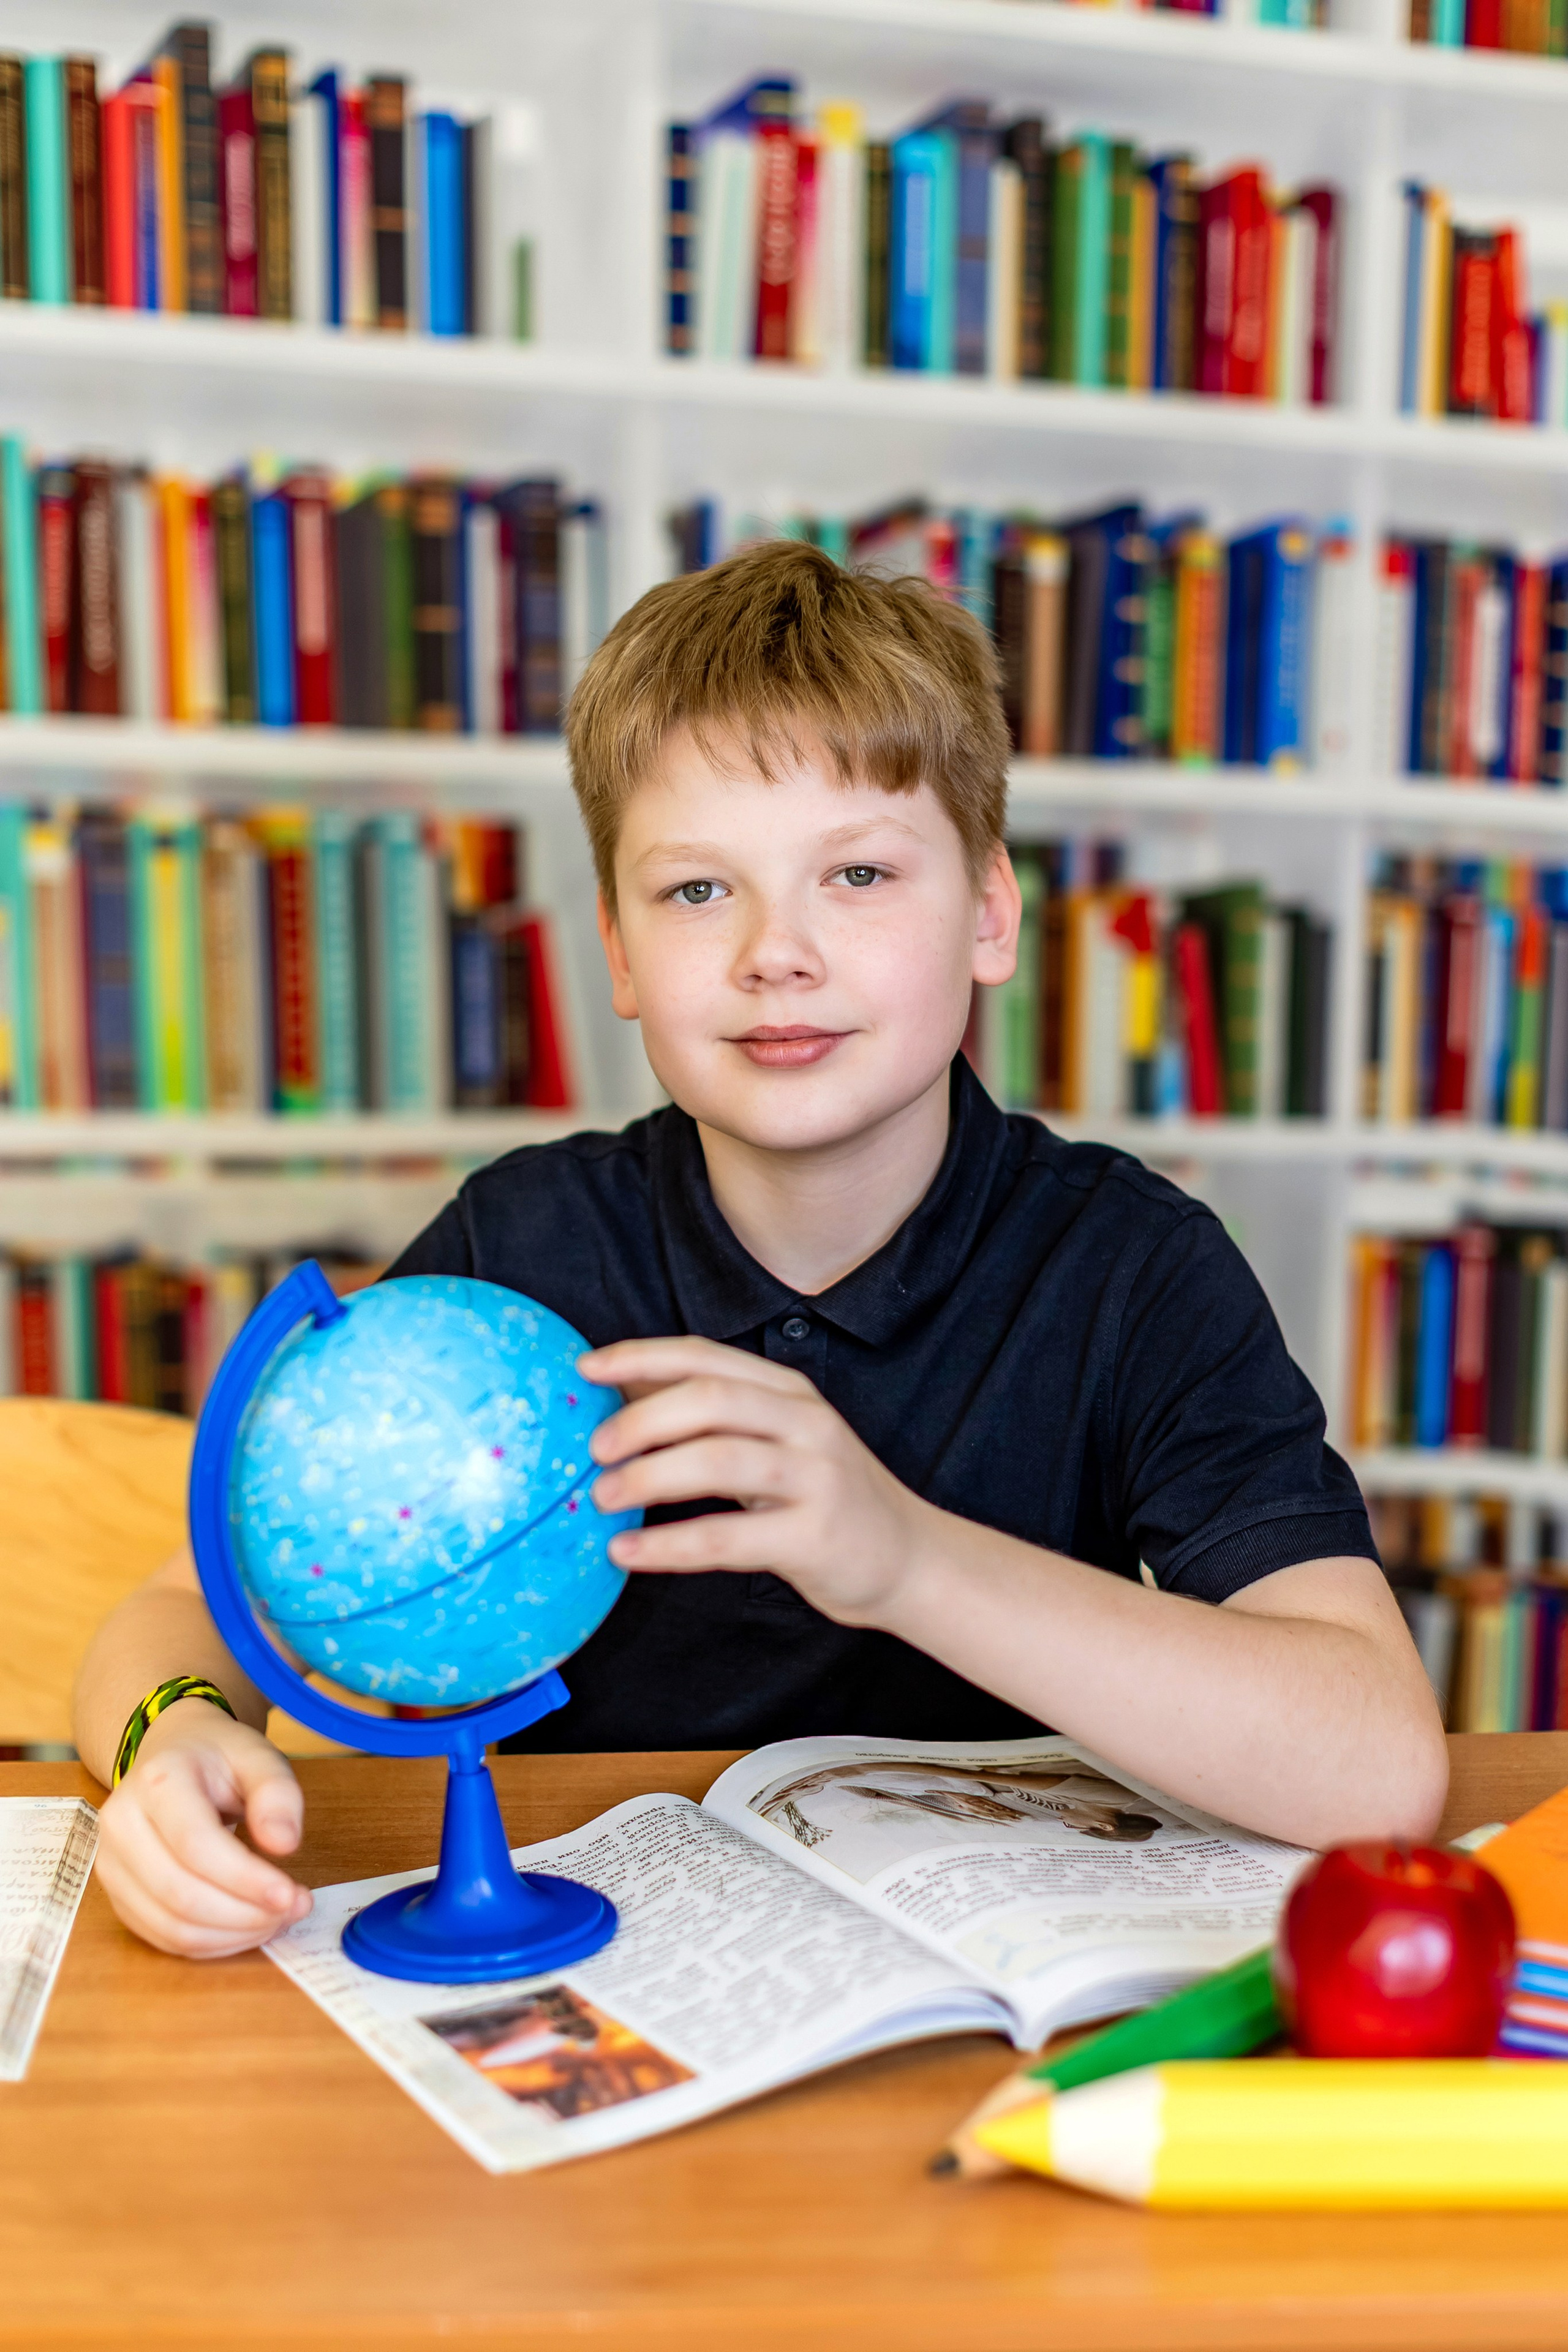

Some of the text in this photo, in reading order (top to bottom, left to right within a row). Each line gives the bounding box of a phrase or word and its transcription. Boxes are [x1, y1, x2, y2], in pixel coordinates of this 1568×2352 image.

[615, 1806, 666, 1830] правды,
[627, 1813, 687, 1839] Нагорной
[638, 1812, 667, 1825] Есть
[587, 1834, 611, 1846] ибо
[627, 1817, 687, 1847] поступать
[646, 1830, 669, 1842] них
[573, 1840, 614, 1860] такие:
[619, 1828, 690, 1867] называются
[660, 1836, 703, 1855] «Итак,
[1167, 1839, 1222, 1850] жающих
[1183, 1843, 1231, 1854] делайте
[556, 1849, 581, 1860] они
[556, 1842, 619, 1872] проповеди
[633, 1843, 670, 1864] люди,
[1197, 1849, 1240, 1858] врагов
[633, 1850, 685, 1882] обобщил
[637, 1861, 651, 1871] во
[1216, 1859, 1257, 1869] нужно
[605, 1868, 628, 1880] так
[644, 1877, 677, 1898] будет
